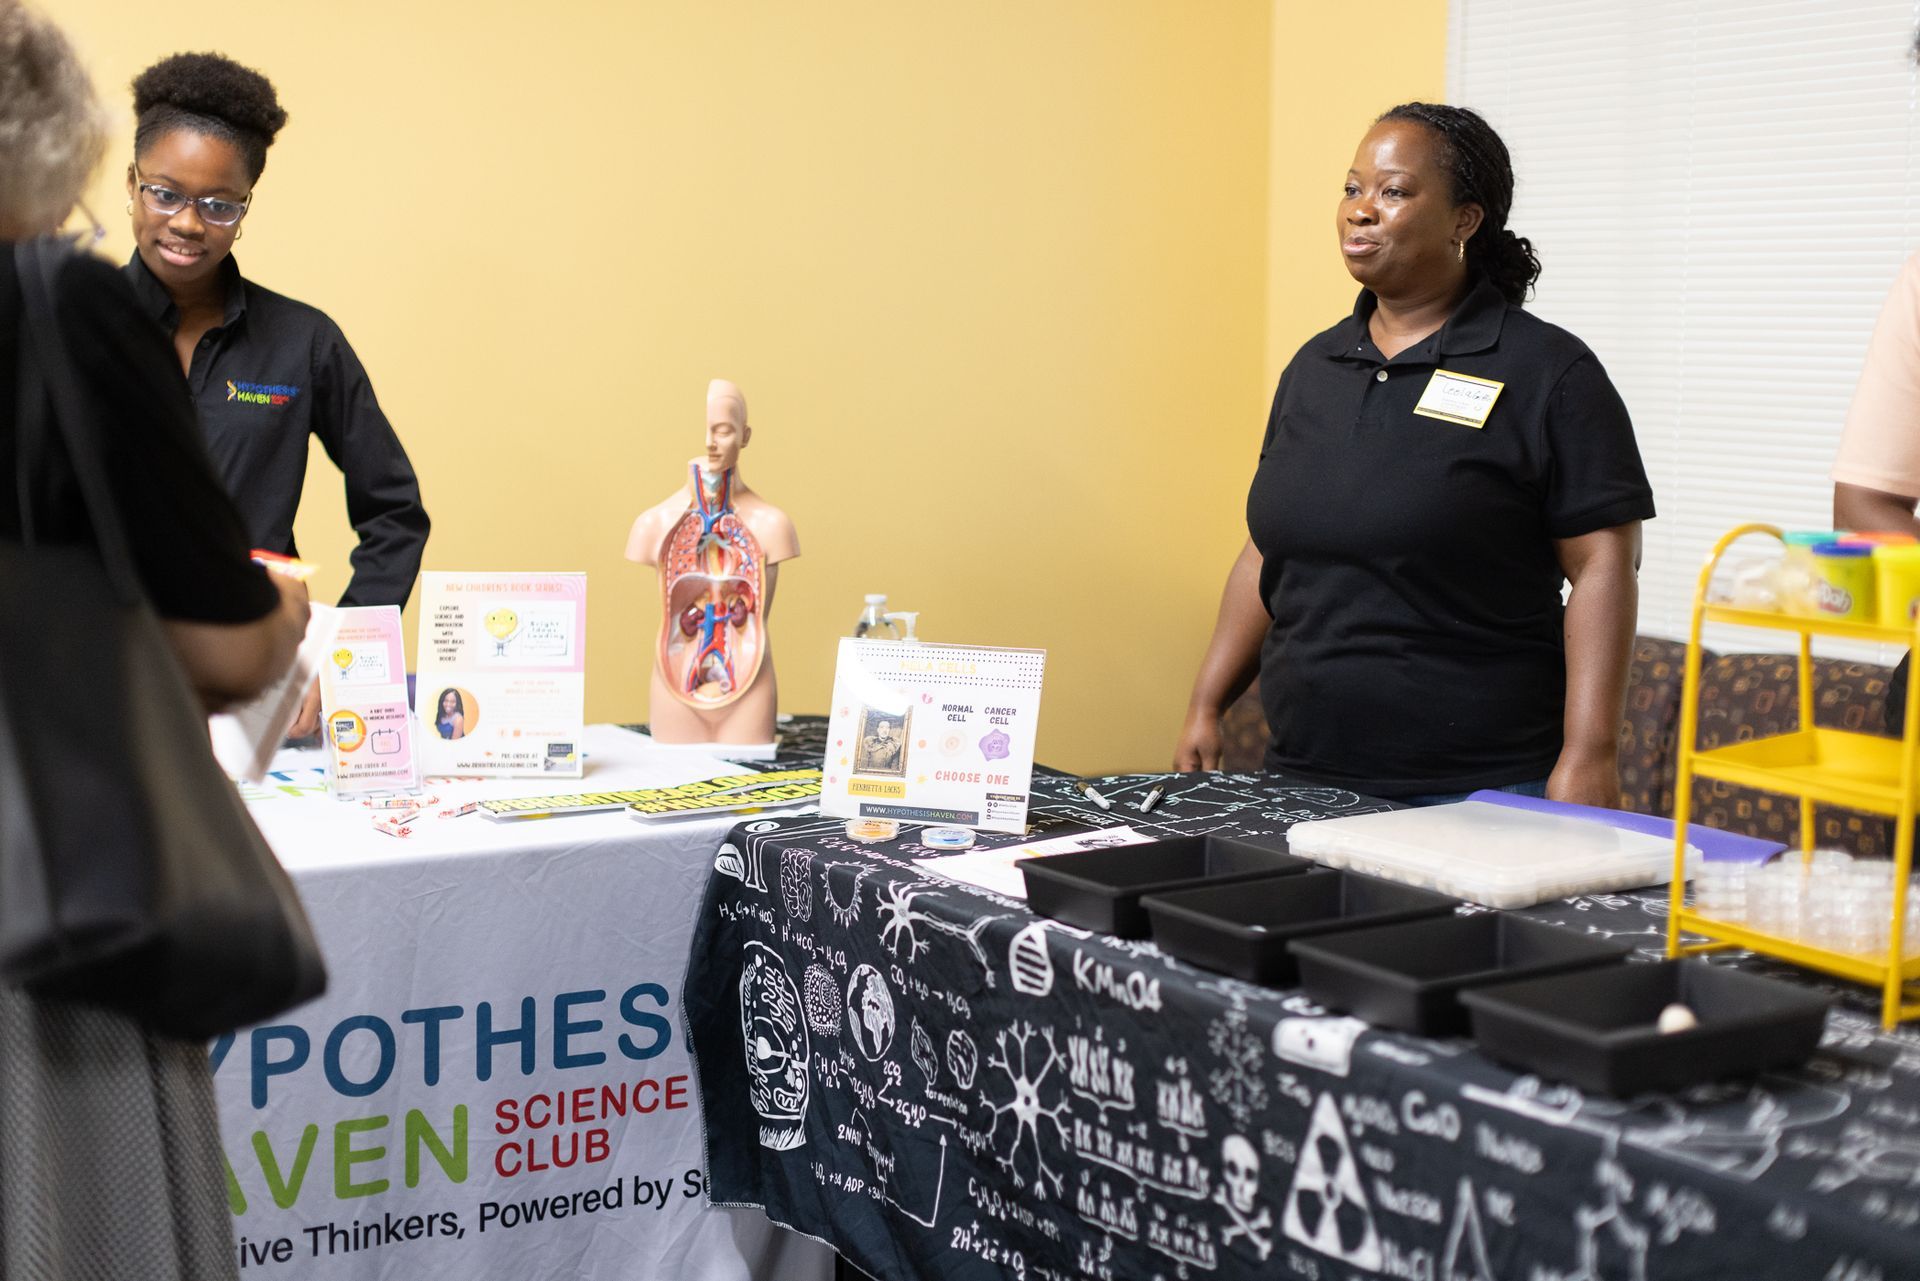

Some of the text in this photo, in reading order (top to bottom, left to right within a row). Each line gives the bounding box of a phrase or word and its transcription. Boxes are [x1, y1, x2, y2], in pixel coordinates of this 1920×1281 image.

[237, 391, 270, 405] HAVEN
[446, 583, 463, 593] NEW
[466, 583, 508, 593] CHILDREN'S
[511, 583, 532, 593] BOOK
[937, 662, 977, 675] CELLS
[942, 704, 1017, 717] NORMAL CANCER
[947, 714, 967, 723] CELL
[989, 716, 1009, 726] CELL
[935, 770, 1010, 786] CHOOSE ONE
[866, 806, 973, 822] WWW.HYPOTHESISHAVEN.COM
[1073, 948, 1163, 1012] KMnO4
[208, 982, 695, 1110] POTHES
[883, 1060, 902, 1087] 2CO2
[494, 1075, 688, 1135] SCIENCE
[494, 1128, 610, 1178] CLUB
[844, 1176, 865, 1193] ADP
[236, 1232, 294, 1268] ive
[303, 1211, 466, 1258] Thinkers,
[479, 1177, 623, 1233] Powered
[634, 1172, 674, 1210] by
